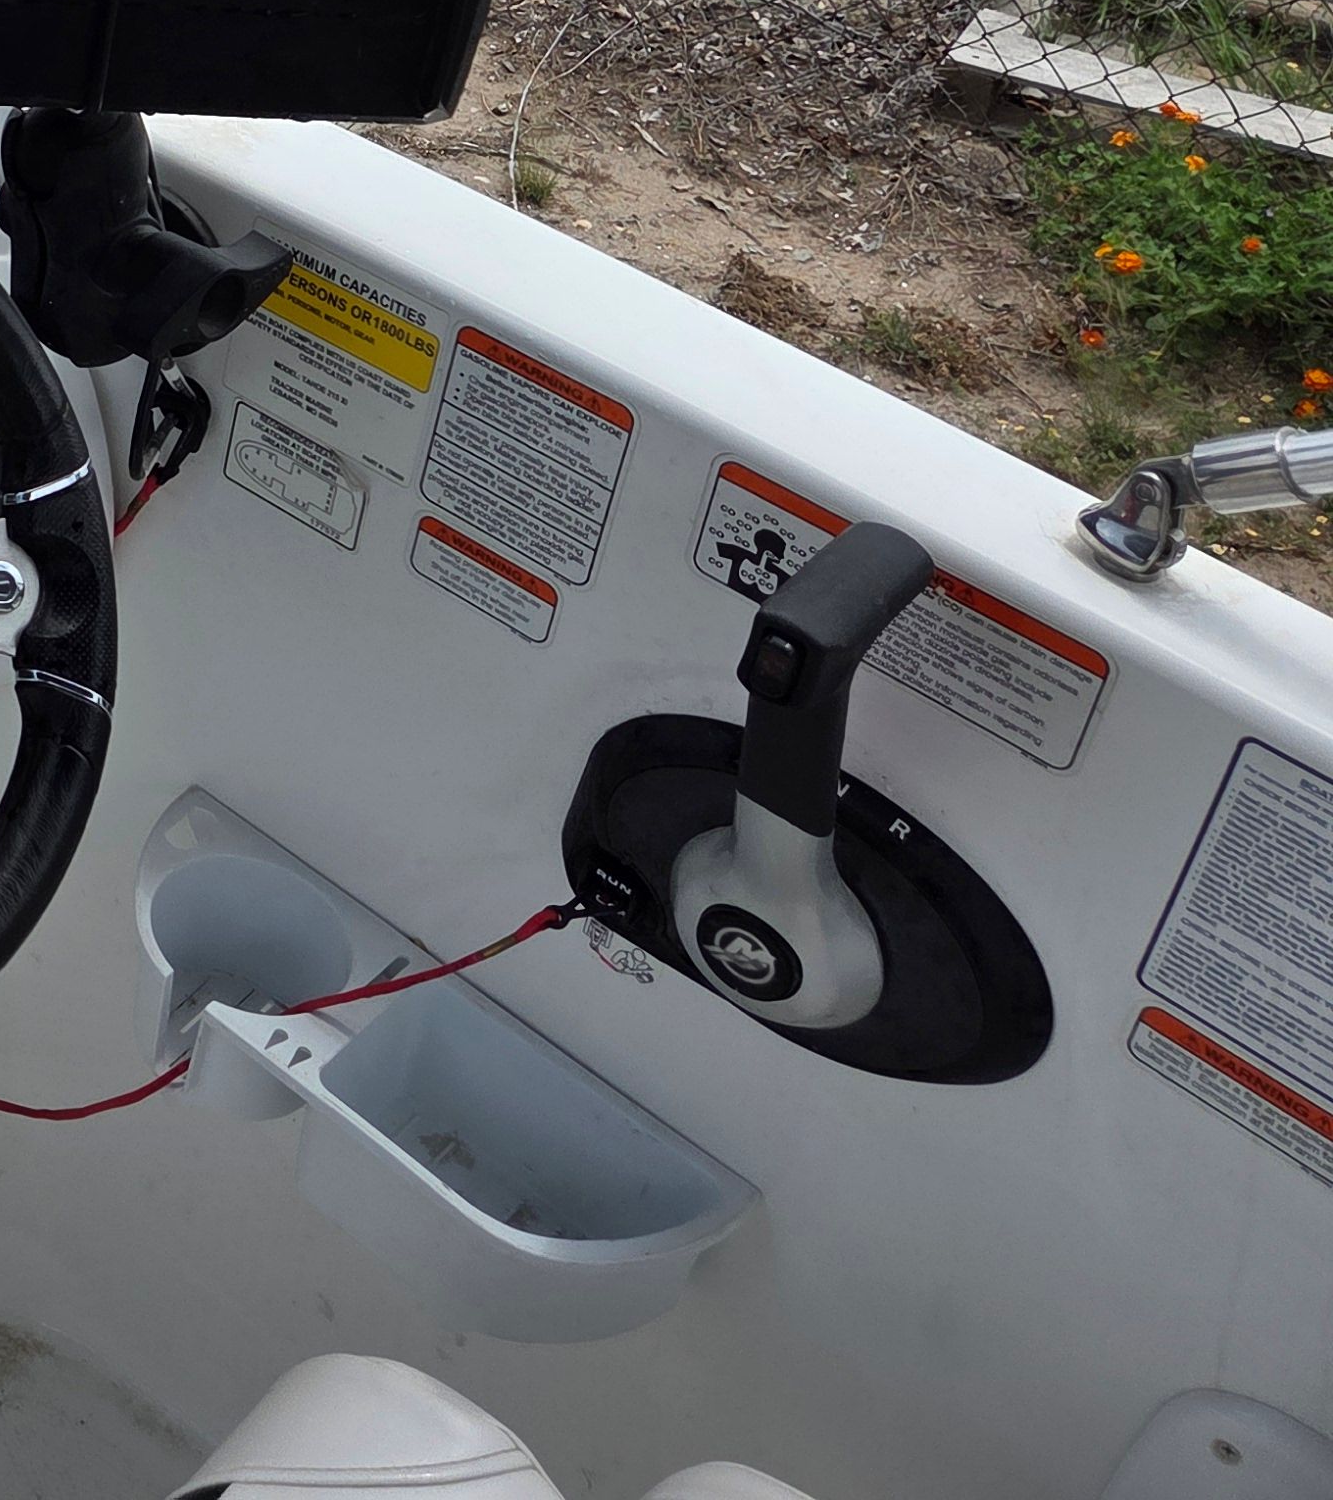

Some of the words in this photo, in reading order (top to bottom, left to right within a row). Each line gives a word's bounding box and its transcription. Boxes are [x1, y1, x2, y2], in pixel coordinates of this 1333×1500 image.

[287, 271, 348, 313] ERSONS
[337, 271, 428, 328] CAPACITIES
[503, 351, 584, 401] WARNING
[451, 533, 523, 583] WARNING
[935, 593, 964, 617] (CO)
[888, 818, 911, 841] R
[596, 868, 632, 896] RUN
[1202, 1044, 1311, 1120] WARNING
